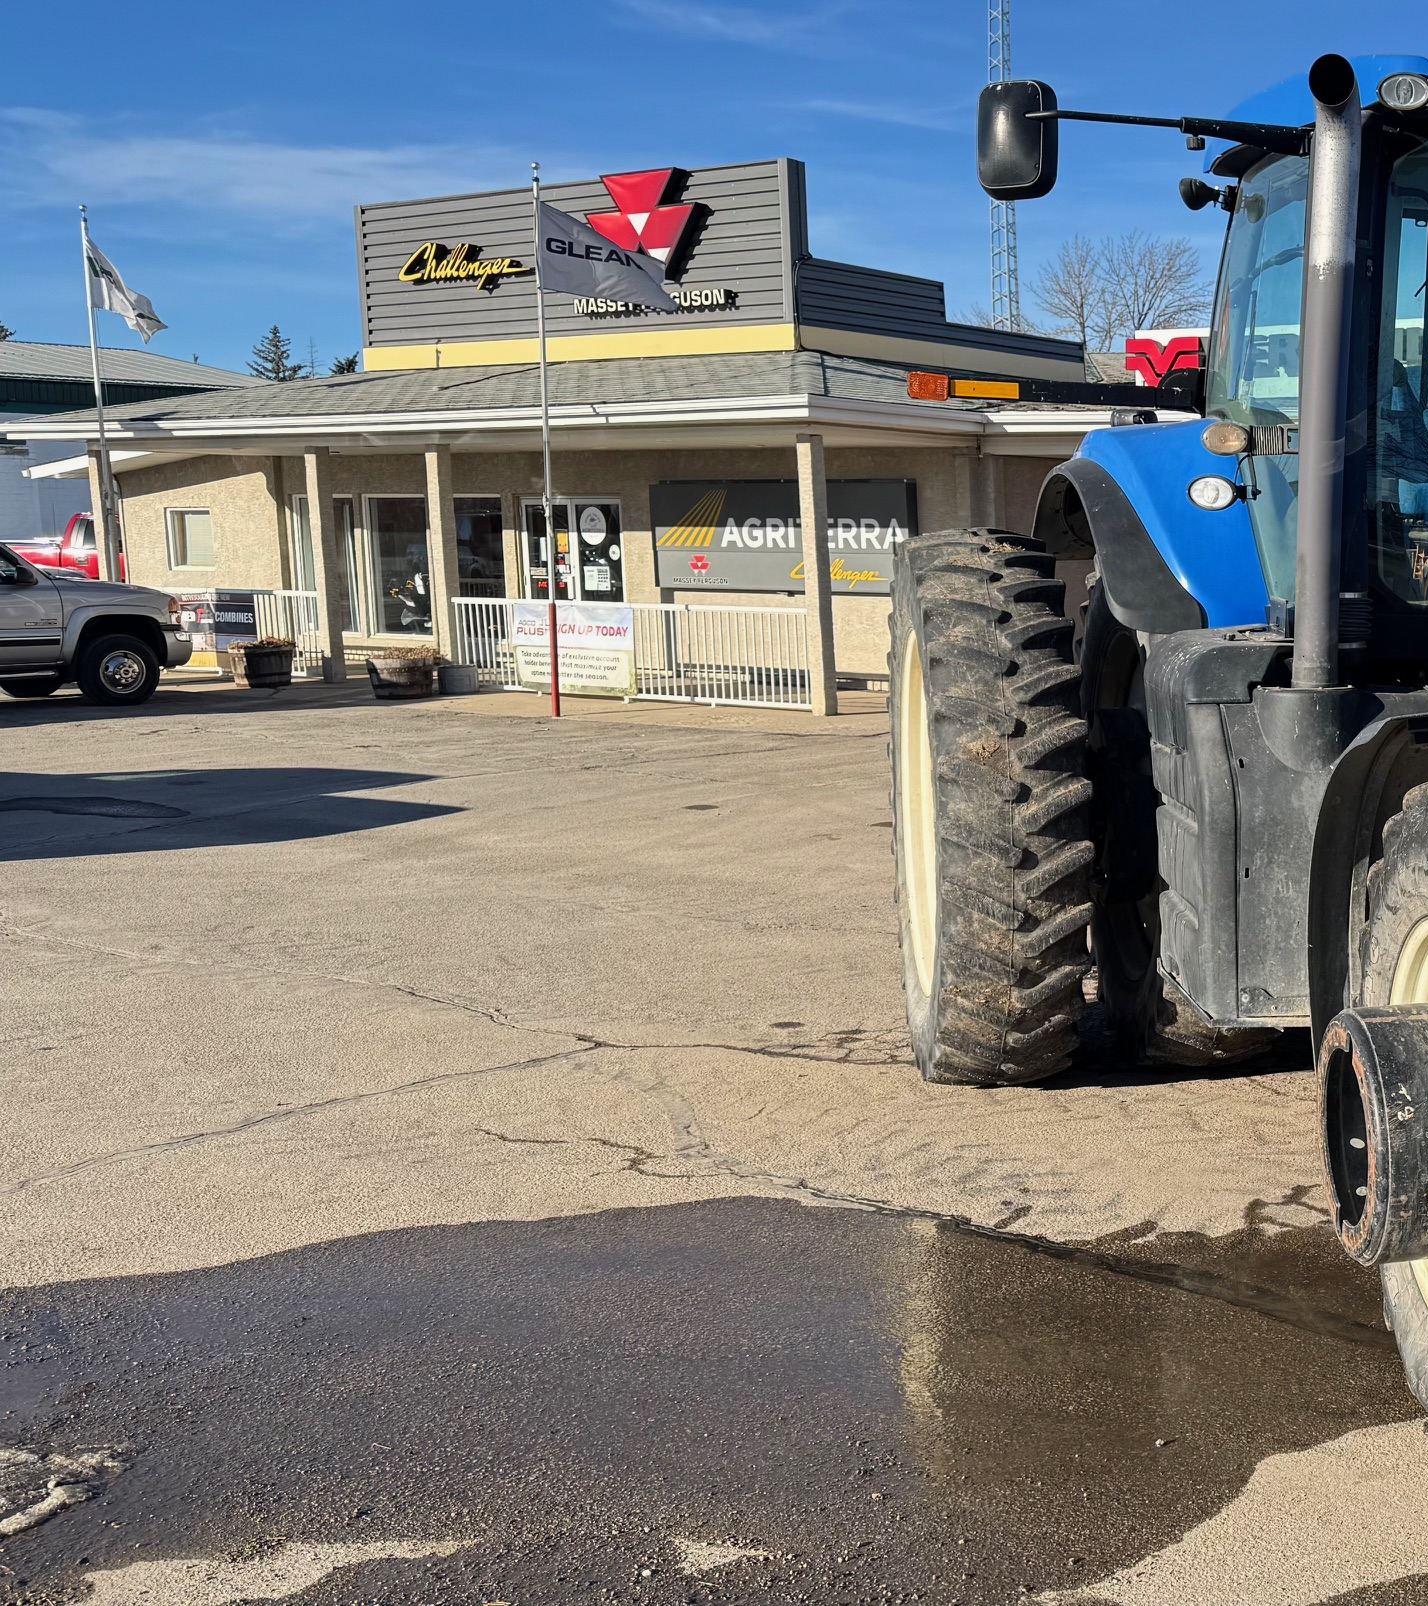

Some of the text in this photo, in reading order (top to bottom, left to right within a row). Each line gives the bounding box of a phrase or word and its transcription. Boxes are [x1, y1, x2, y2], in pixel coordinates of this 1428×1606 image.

[398, 242, 531, 291] Challenger
[721, 517, 907, 550] AGRIERRA
[215, 611, 254, 623] COMBINES
[557, 623, 628, 637] IGN UP TODAY
[603, 664, 617, 672] your
